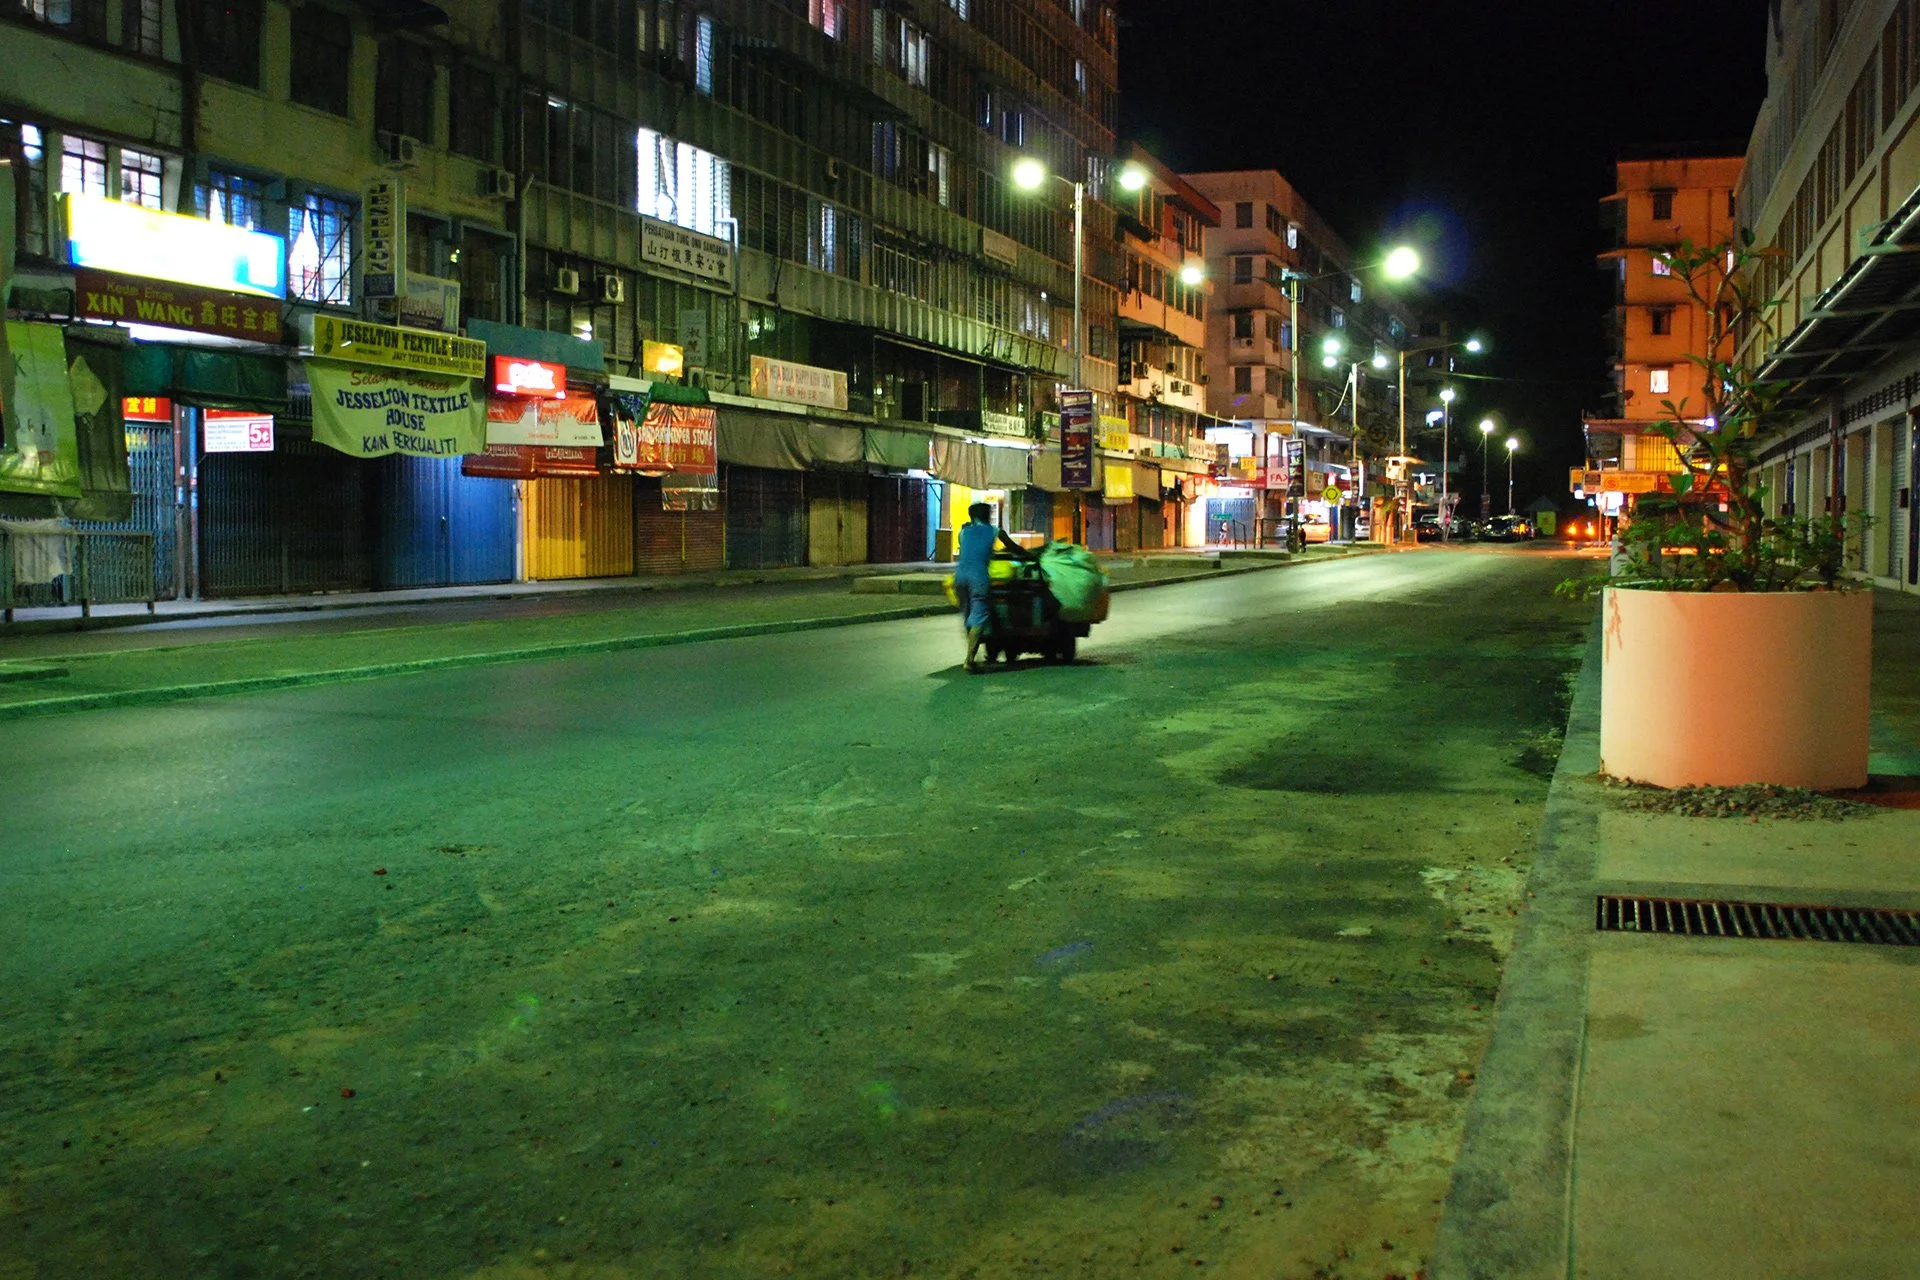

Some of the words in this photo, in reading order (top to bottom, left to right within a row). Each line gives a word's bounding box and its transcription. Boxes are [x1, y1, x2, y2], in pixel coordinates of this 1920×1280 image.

[86, 291, 125, 316] XIN
[136, 300, 194, 326] WANG
[402, 332, 448, 356] TEXTILE
[451, 340, 484, 360] HOUSE
[336, 387, 410, 409] JESSELTON
[412, 392, 469, 413] TEXTILE
[386, 408, 426, 431] HOUSE
[392, 430, 457, 454] BERKUALITI
